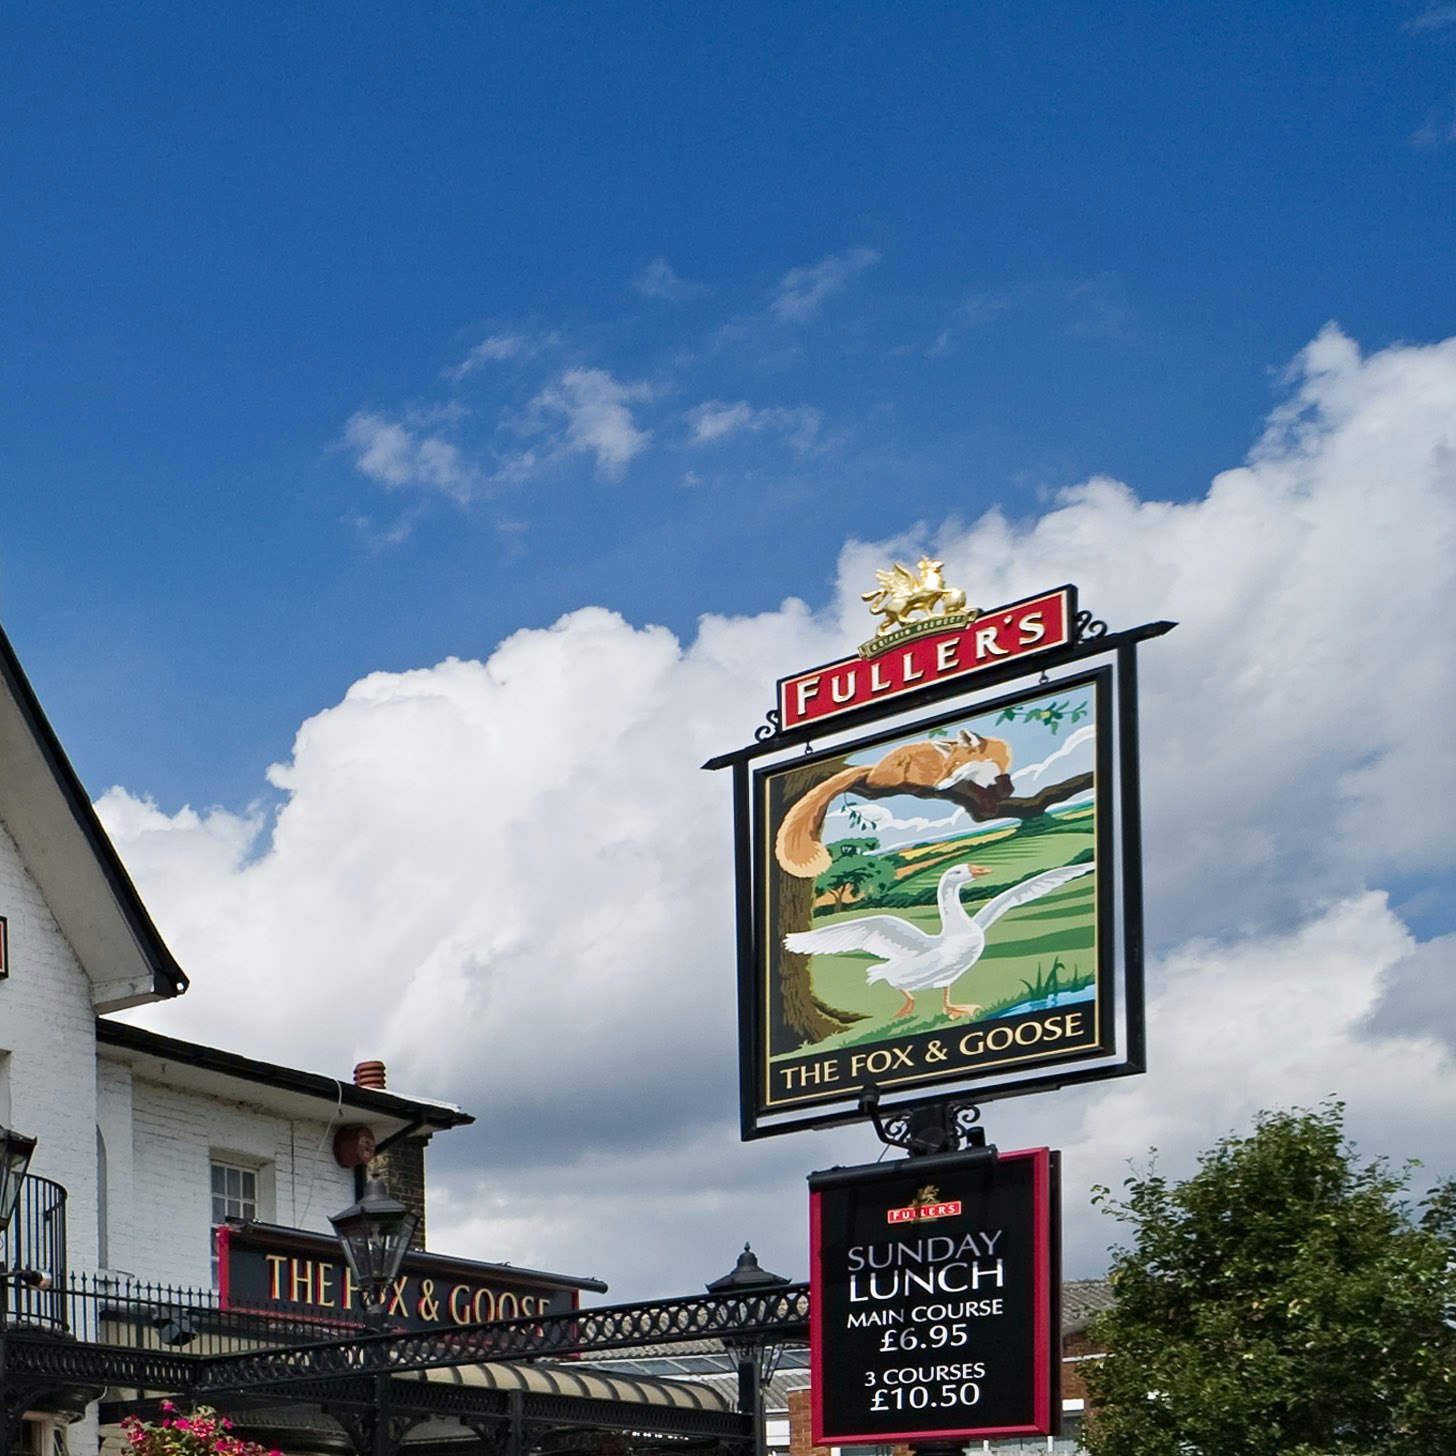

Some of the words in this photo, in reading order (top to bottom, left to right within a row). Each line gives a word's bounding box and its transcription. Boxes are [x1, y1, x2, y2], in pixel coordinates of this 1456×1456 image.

[796, 611, 1046, 716] FULLER'S
[780, 1060, 839, 1090] THE
[851, 1045, 915, 1078] FOX
[924, 1040, 948, 1063] &
[959, 1013, 1084, 1056] GOOSE
[847, 1230, 1003, 1271] SUNDAY
[265, 1254, 335, 1307] THE
[342, 1266, 409, 1318] FX
[418, 1278, 439, 1322] &
[849, 1258, 1004, 1302] LUNCH
[847, 1309, 904, 1329] MAIN
[911, 1299, 1004, 1323] COURSE
[879, 1323, 968, 1352] £6.95
[864, 1371, 876, 1387] 3
[883, 1362, 986, 1386] COURSES
[870, 1383, 980, 1411] £10.50
